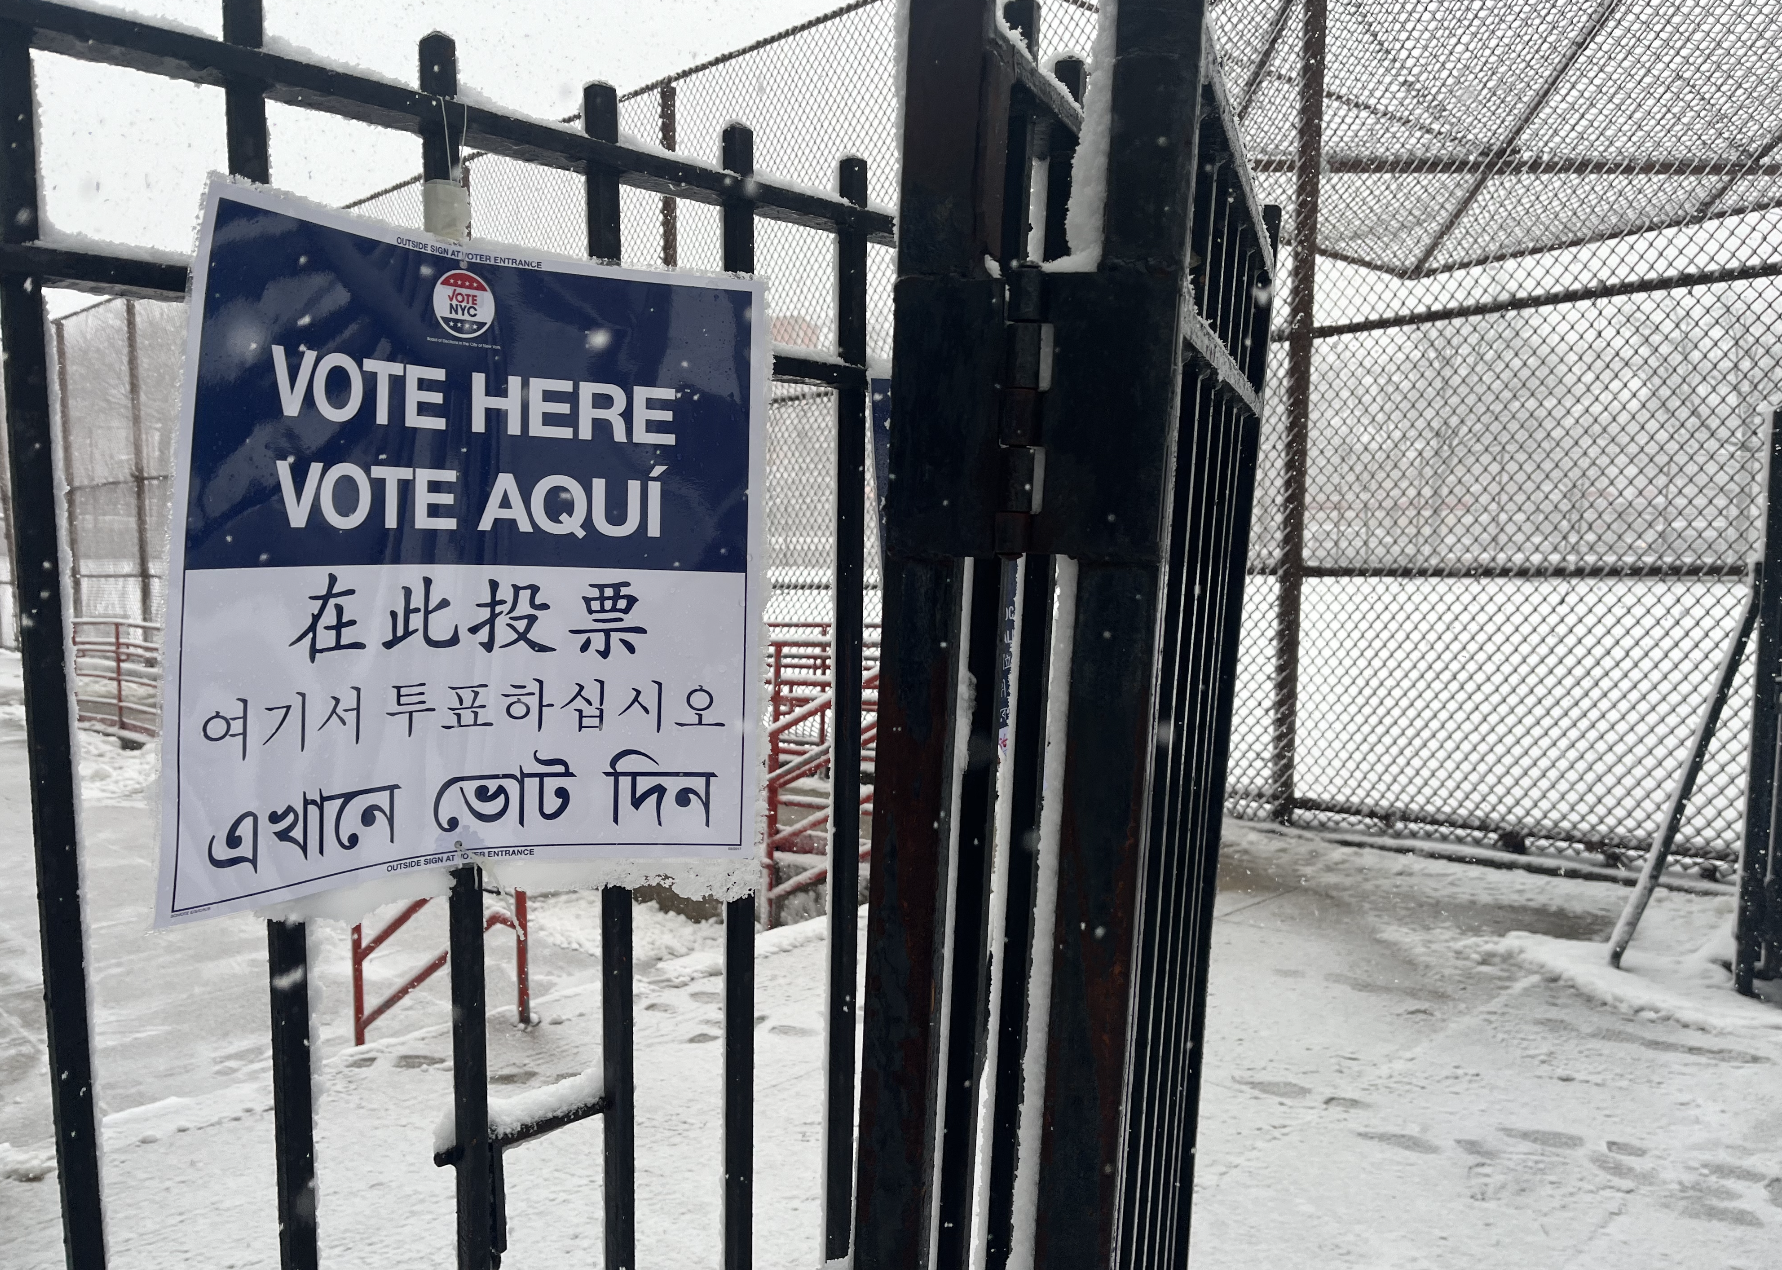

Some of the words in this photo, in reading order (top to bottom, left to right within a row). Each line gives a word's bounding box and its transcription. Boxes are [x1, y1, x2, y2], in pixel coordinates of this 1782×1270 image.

[396, 236, 429, 250] OUTSIDE
[430, 244, 449, 256] SIGN
[450, 250, 460, 258] AT
[493, 256, 543, 269] ENTRANCE
[449, 303, 478, 318] NYC
[272, 344, 446, 430] VOTE
[472, 372, 676, 446] HERE
[276, 455, 457, 530] VOTE
[477, 465, 668, 540] AQUÍ
[288, 572, 648, 665] 在此投票
[202, 687, 362, 762] 여기서
[386, 677, 726, 739] 투표하십시오
[207, 783, 402, 875] এখানে
[433, 749, 578, 833] ভোট
[602, 748, 719, 829] দিন
[386, 860, 421, 872] OUTSIDE
[423, 856, 443, 867] SIGN
[445, 854, 455, 862] AT
[487, 848, 535, 858] ENTRANCE
